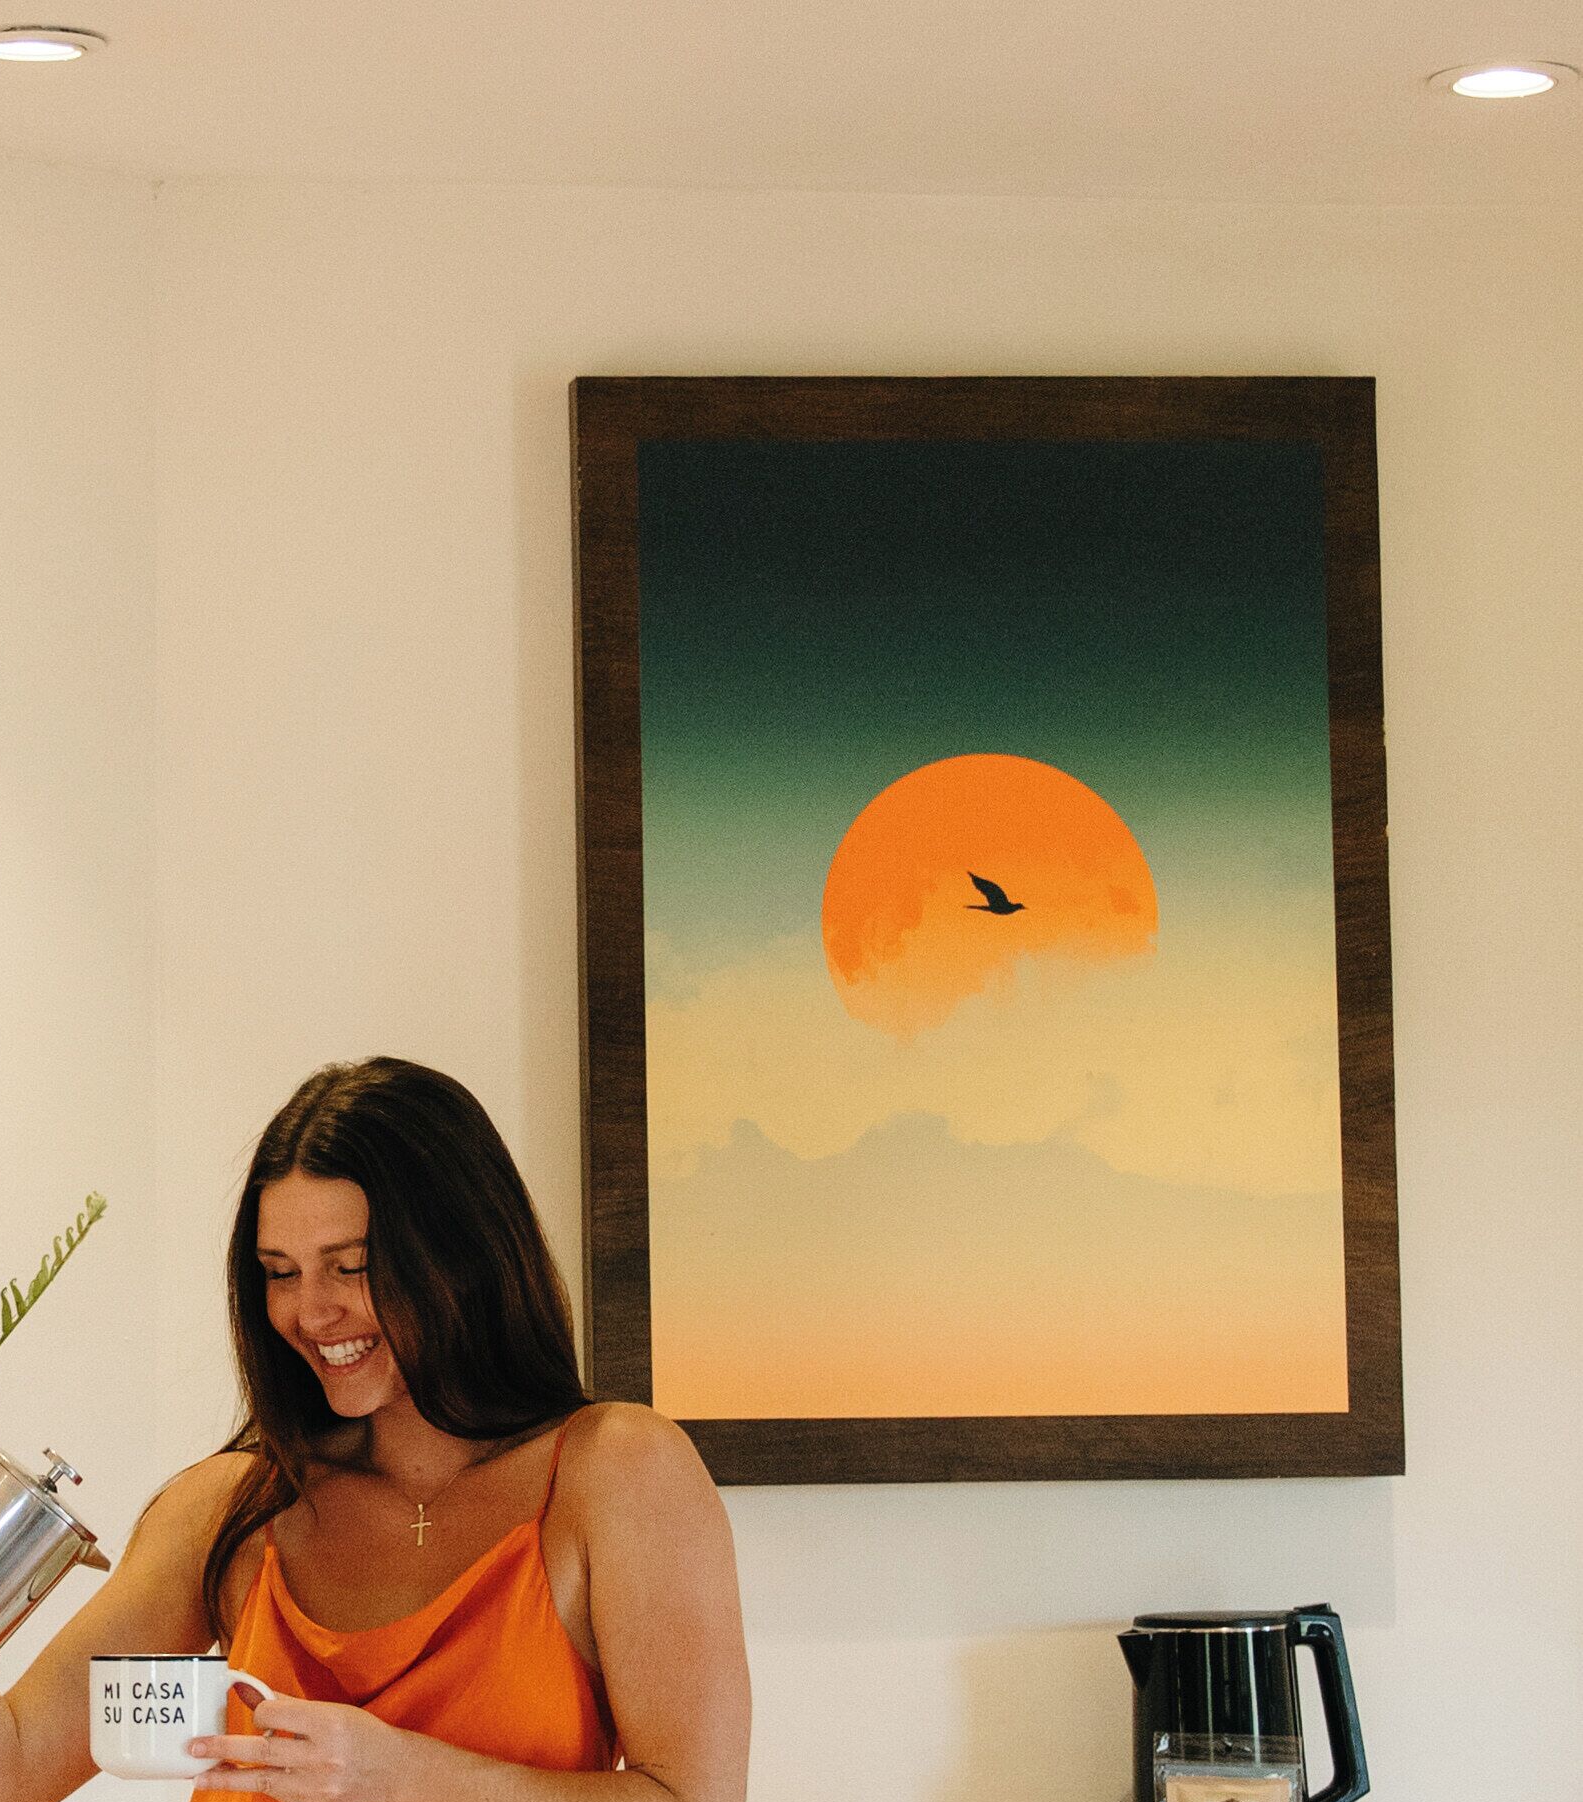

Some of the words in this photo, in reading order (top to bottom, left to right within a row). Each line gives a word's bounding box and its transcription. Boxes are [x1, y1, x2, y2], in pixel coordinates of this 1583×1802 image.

[104, 1682, 121, 1699] MI
[132, 1682, 185, 1699] CASA
[104, 1706, 122, 1724] SU
[132, 1706, 186, 1724] CASA
